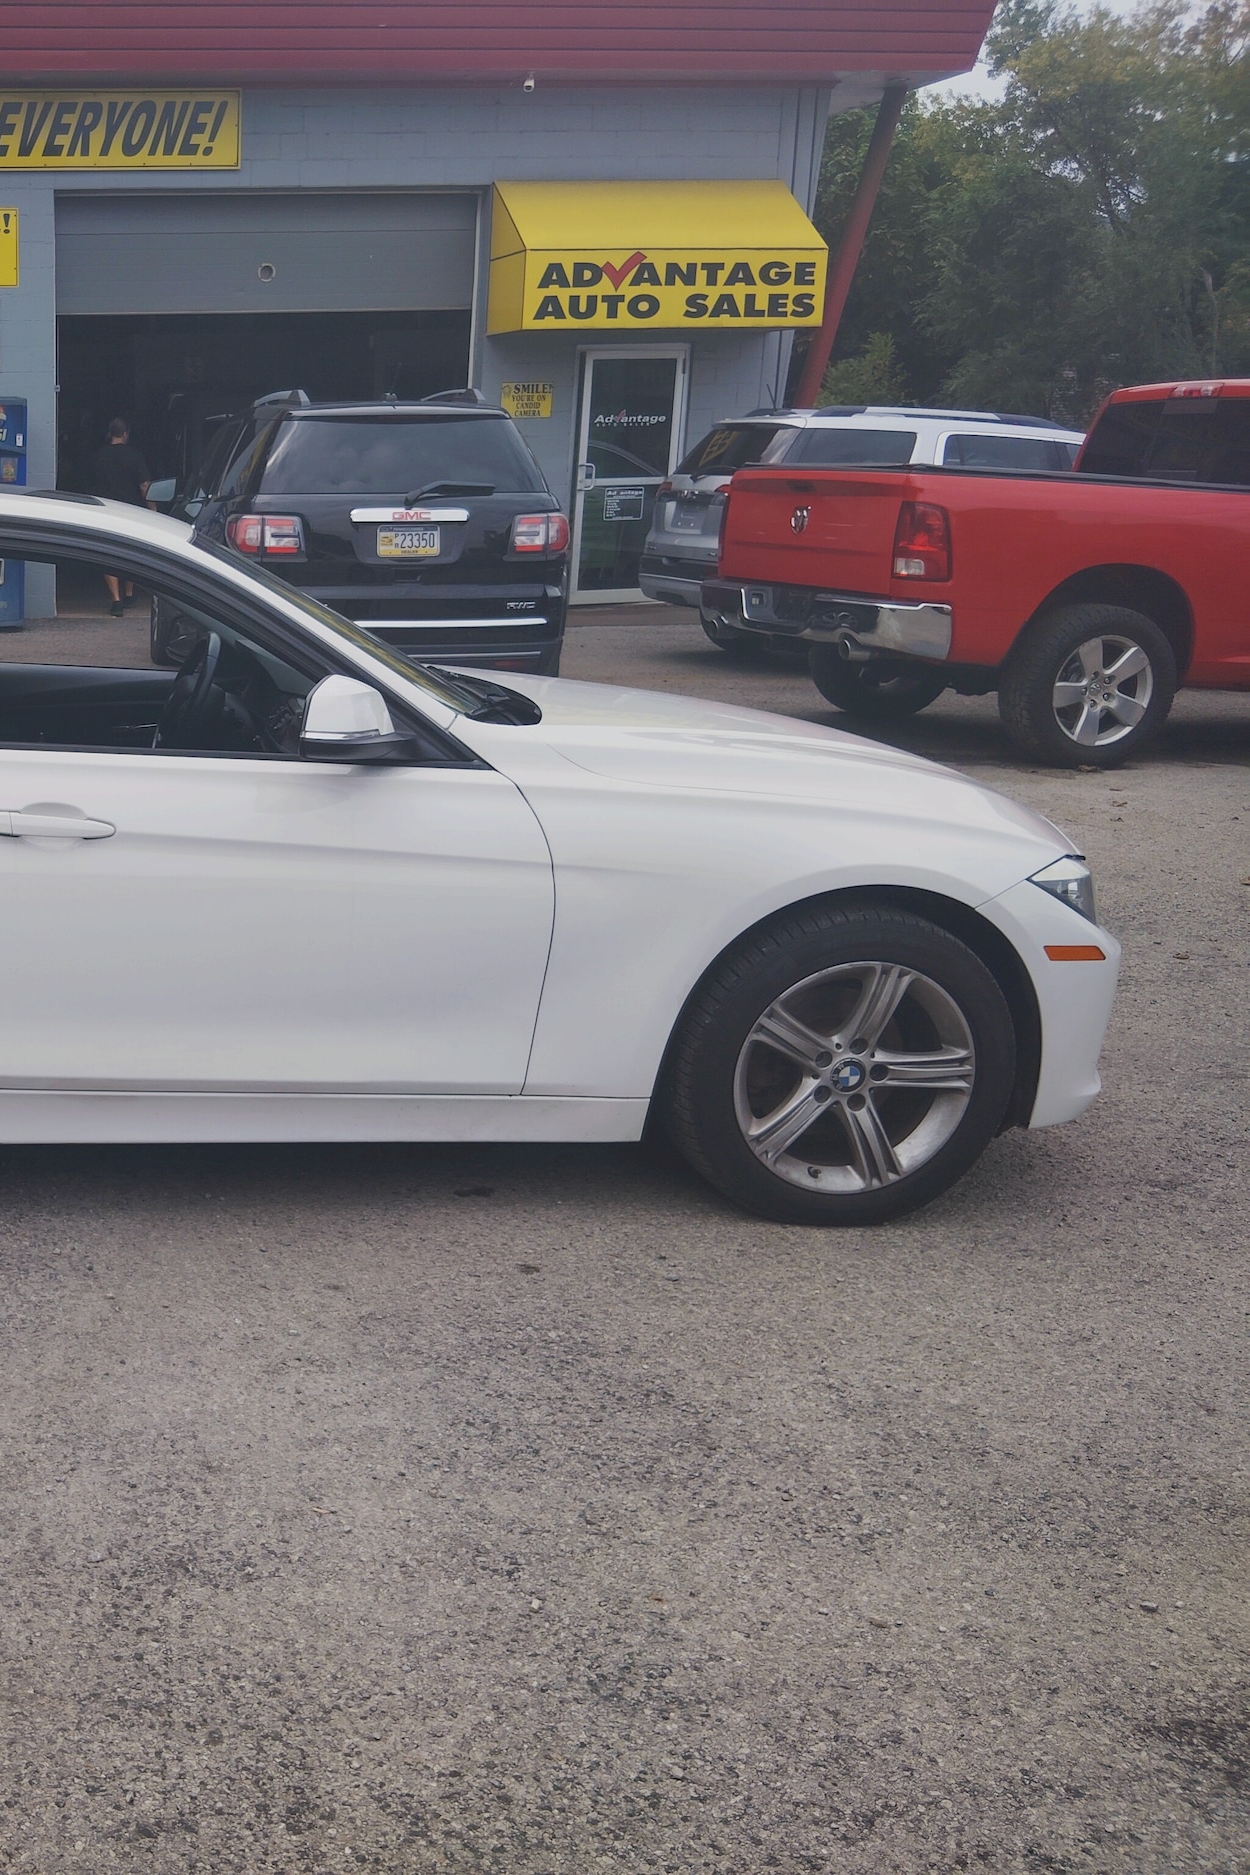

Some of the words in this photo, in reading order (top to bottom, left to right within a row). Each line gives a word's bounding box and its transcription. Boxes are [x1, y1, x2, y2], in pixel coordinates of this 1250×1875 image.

[532, 293, 661, 321] AUTO
[682, 292, 816, 319] SALES
[515, 402, 541, 410] CANDID
[392, 511, 431, 520] GMC
[400, 532, 435, 549] 23350
